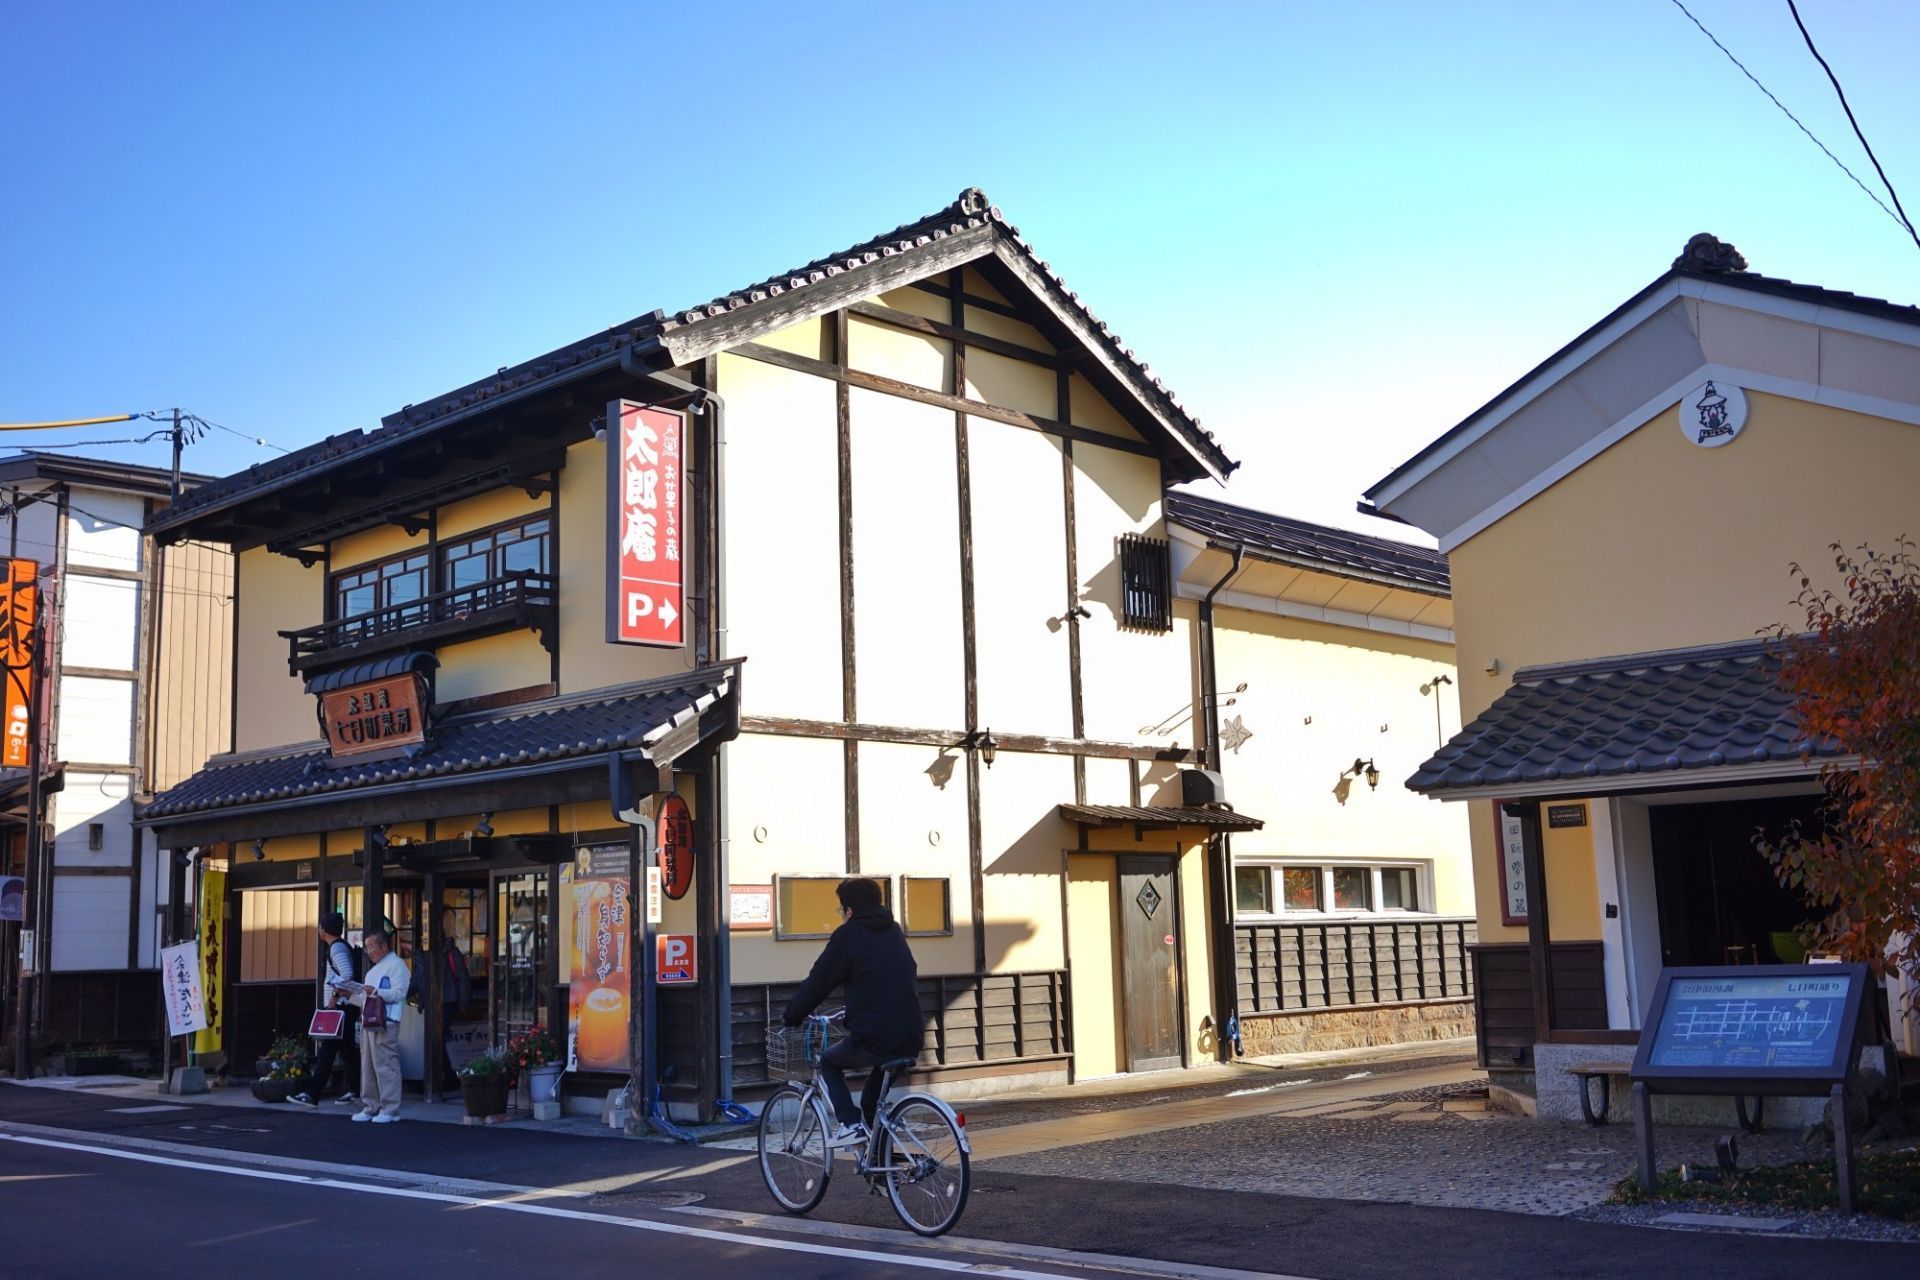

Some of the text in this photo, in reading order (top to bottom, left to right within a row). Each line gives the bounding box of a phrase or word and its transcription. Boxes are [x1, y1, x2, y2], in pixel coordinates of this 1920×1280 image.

[623, 416, 659, 562] 太郎庵
[664, 464, 680, 561] お菓子の蔵
[628, 592, 653, 627] P
[666, 939, 687, 966] P
[1788, 983, 1840, 992] 七日町通り
